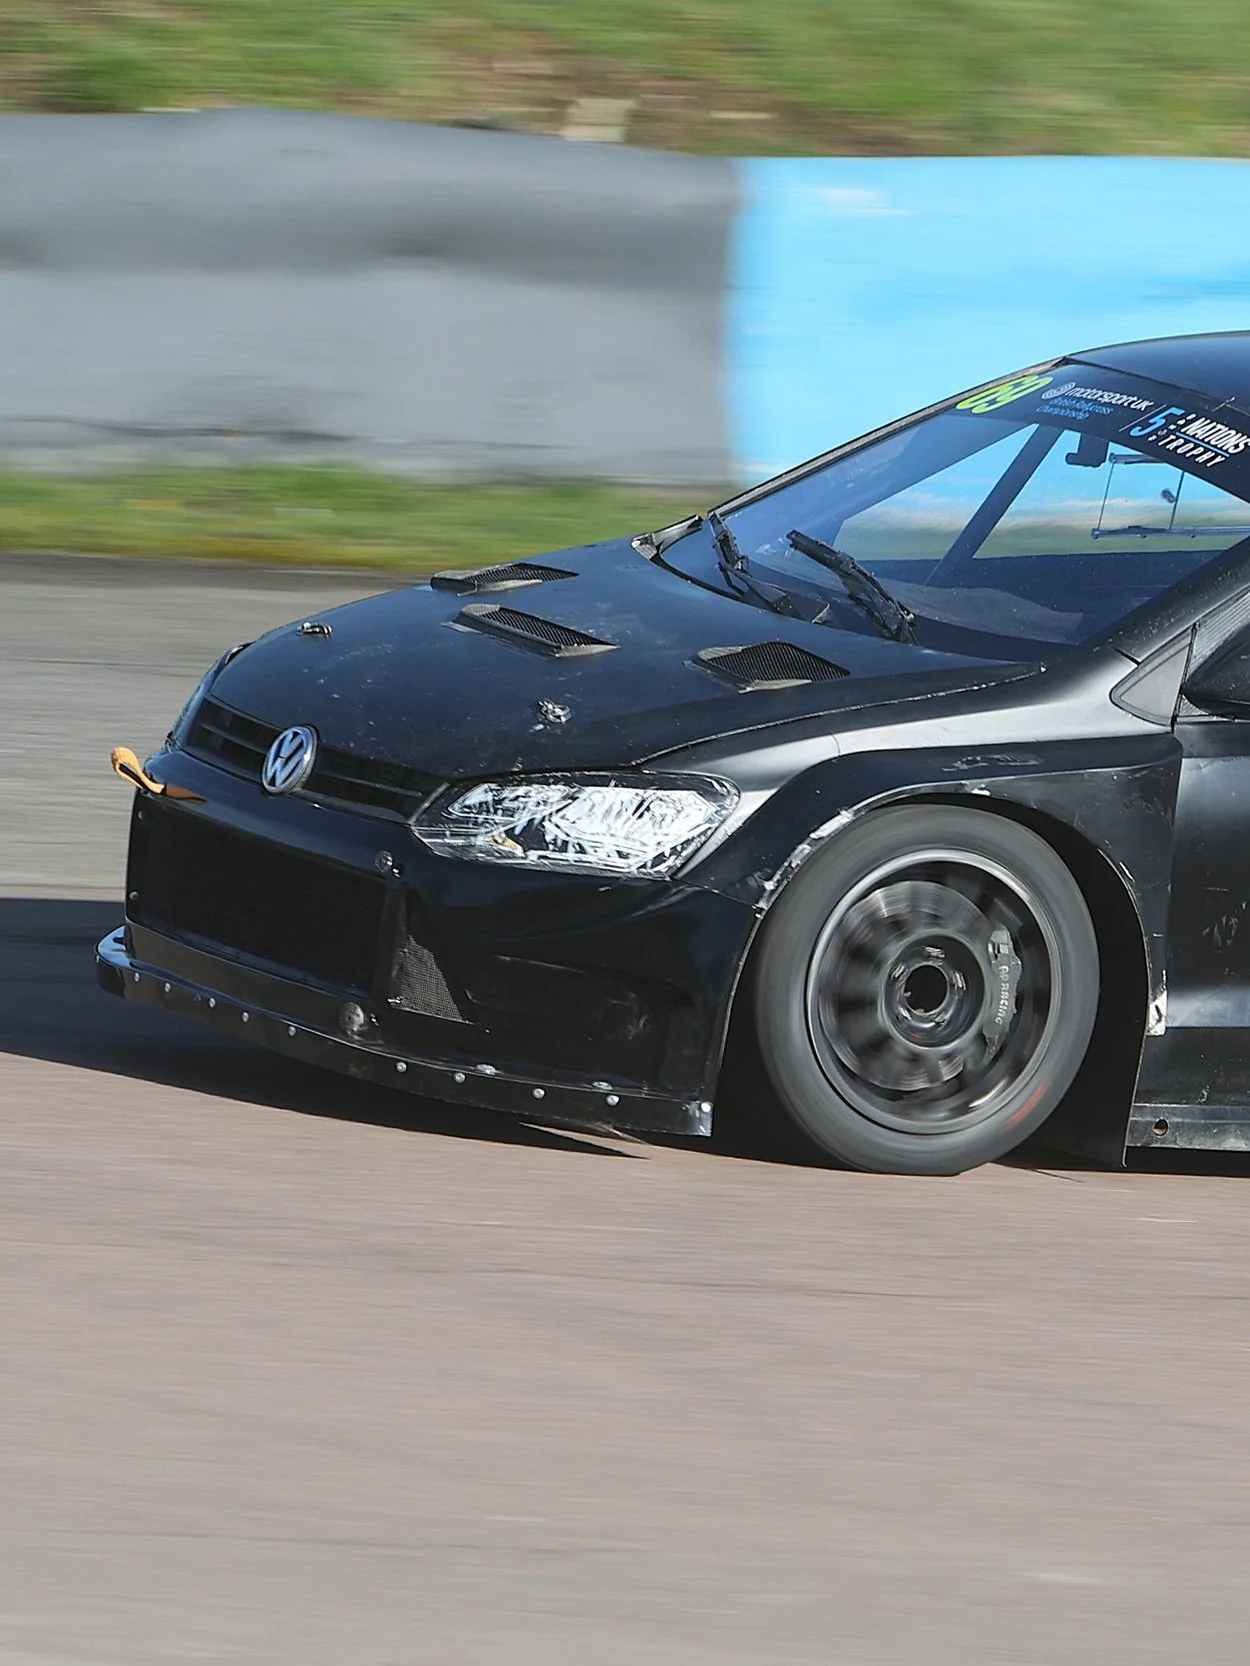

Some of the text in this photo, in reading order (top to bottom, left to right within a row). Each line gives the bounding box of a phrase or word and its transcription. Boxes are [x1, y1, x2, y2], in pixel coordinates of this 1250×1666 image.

[1064, 386, 1137, 407] motorsport
[1129, 406, 1186, 437] 5
[1158, 434, 1226, 467] TROPHY
